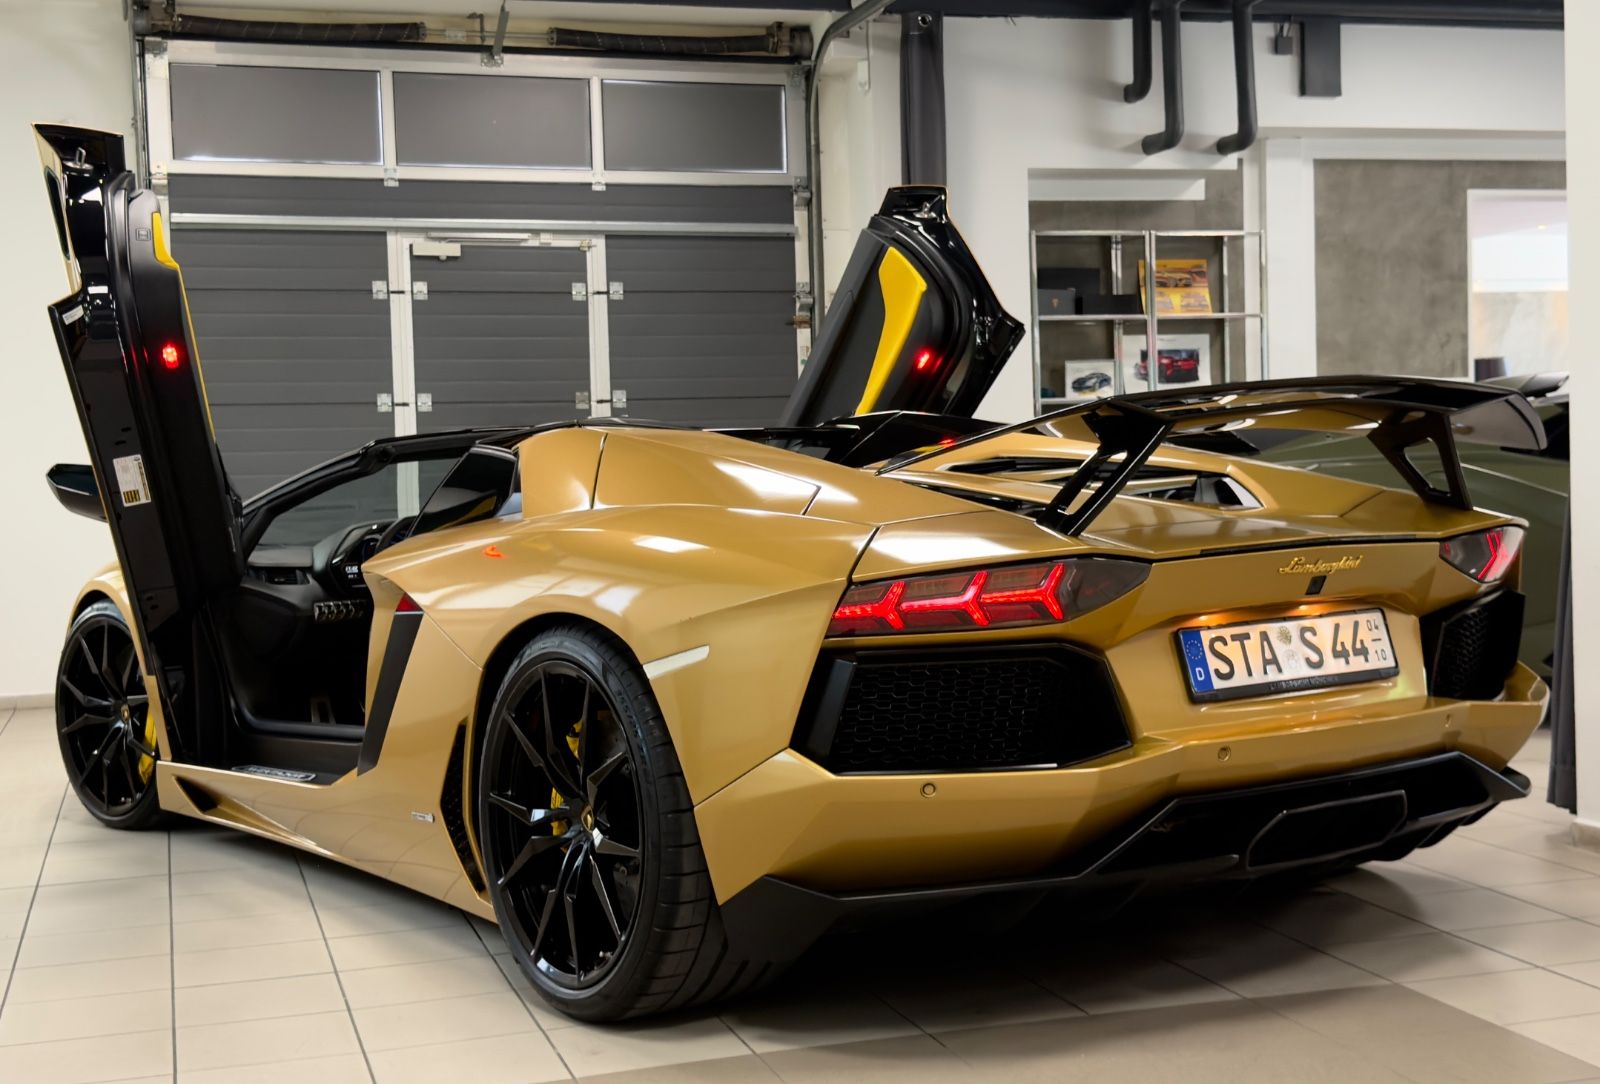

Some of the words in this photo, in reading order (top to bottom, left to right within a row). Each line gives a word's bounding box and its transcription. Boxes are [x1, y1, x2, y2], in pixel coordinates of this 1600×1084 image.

[1279, 555, 1364, 574] Lamborghini
[1366, 619, 1379, 632] 04
[1195, 667, 1206, 681] D
[1208, 631, 1283, 681] STA
[1300, 626, 1325, 669] S
[1331, 620, 1369, 665] 44
[1375, 648, 1388, 662] 10
